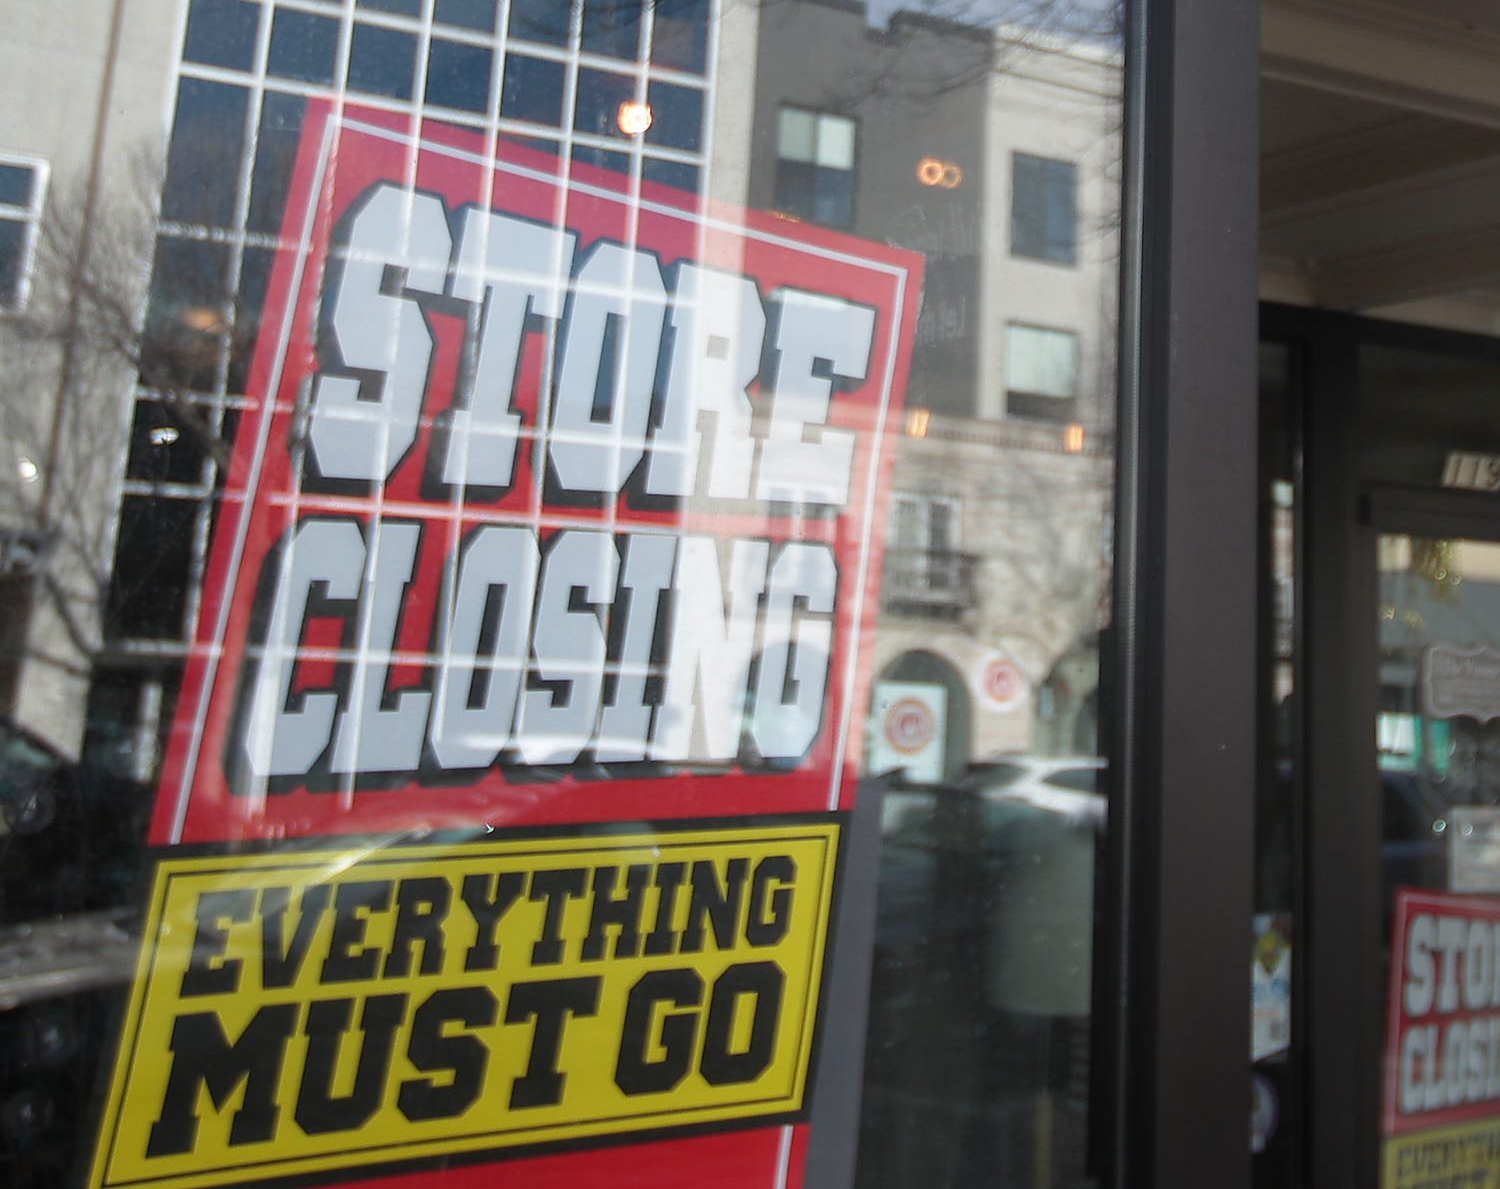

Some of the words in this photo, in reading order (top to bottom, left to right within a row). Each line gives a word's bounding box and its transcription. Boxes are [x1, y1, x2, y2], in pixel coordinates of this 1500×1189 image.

[306, 182, 878, 506] STORE
[244, 518, 838, 778] CLOSING
[178, 855, 798, 999] EVERYTHING
[145, 974, 602, 1159] MUST
[614, 959, 789, 1097] GO
